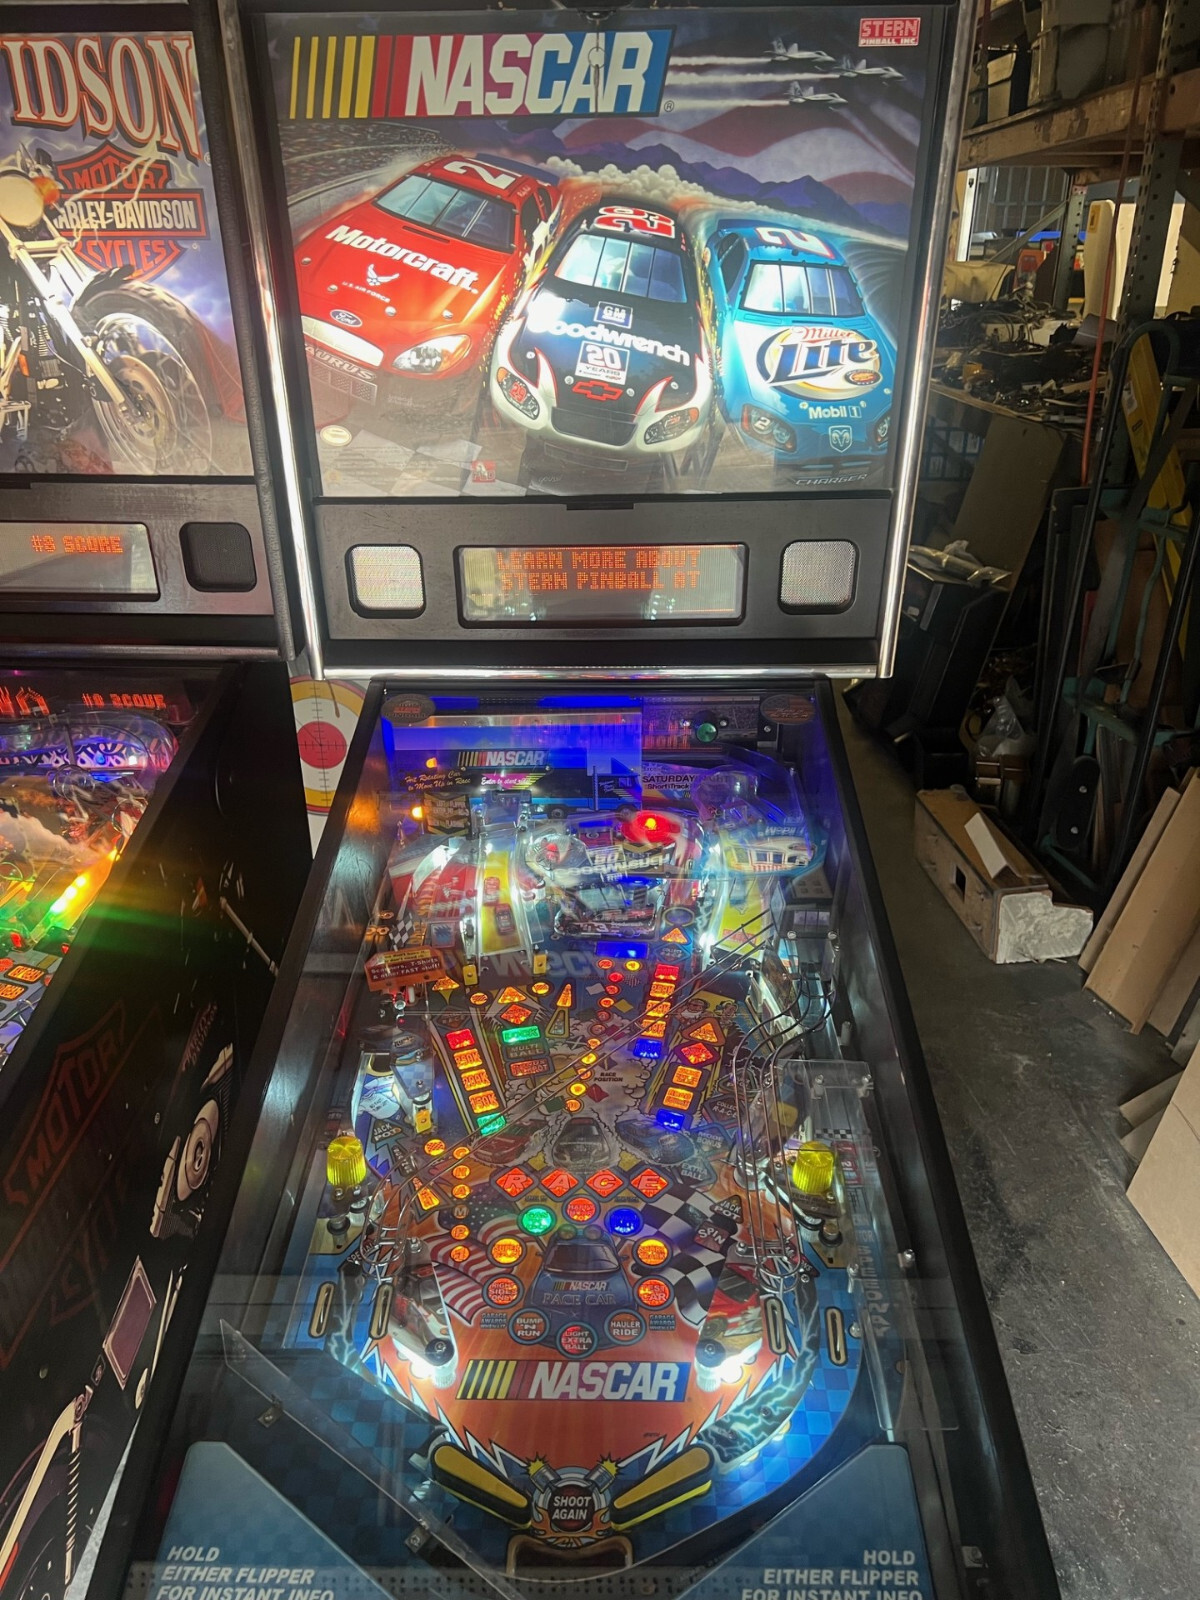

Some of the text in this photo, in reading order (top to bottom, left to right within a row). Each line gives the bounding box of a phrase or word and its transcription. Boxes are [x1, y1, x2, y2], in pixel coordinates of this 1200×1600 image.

[861, 20, 918, 37] STERN
[860, 37, 896, 45] PINBALL
[404, 32, 653, 116] NASCAR
[2, 37, 202, 166] IDSON
[74, 156, 157, 190] MOTOR
[53, 200, 197, 230] ARLEY-DAVIDSON
[85, 240, 167, 271] CYCLES
[325, 225, 479, 293] Motorcraft
[799, 326, 854, 340] Miller
[529, 318, 691, 367] oodwrench
[305, 344, 376, 381] AURUS
[586, 344, 623, 371] 20
[769, 339, 880, 385] Lite
[808, 405, 847, 419] Mobil
[794, 473, 868, 486] CHARGER
[63, 535, 124, 553] SCORE
[497, 550, 701, 570] LEARN MORE ABOUT
[501, 570, 701, 591] STERN PINBALL AT
[486, 750, 545, 766] NASCAR
[642, 774, 696, 783] SATURDAY
[401, 967, 419, 976] FAST
[510, 1043, 539, 1052] MULTI
[510, 1049, 544, 1059] BALL
[716, 1100, 738, 1111] COLLEC
[373, 1123, 392, 1136] JACK
[681, 1162, 708, 1176] EXTRA
[503, 1174, 661, 1191] R A C E
[713, 1205, 741, 1221] POT
[719, 1199, 741, 1213] JACK
[698, 1227, 726, 1246] SPIN
[569, 1281, 607, 1291] NASCAR
[642, 1285, 666, 1293] TEST
[585, 1293, 617, 1305] CAR
[642, 1293, 667, 1302] CAR
[517, 1330, 541, 1338] RUN
[612, 1328, 639, 1336] RIDE
[527, 1361, 680, 1400] NASCAR
[552, 1496, 592, 1506] SHOOT
[551, 1508, 588, 1520] AGAIN
[166, 1546, 220, 1562] HOLD
[863, 1550, 915, 1565] HOLD
[161, 1565, 315, 1585] EITHER FLIPPER
[763, 1568, 919, 1586] EITHER FLIPPER
[155, 1585, 334, 1600] FOR INSTANT INFO
[741, 1588, 923, 1600] FOR INSTANT INFO
